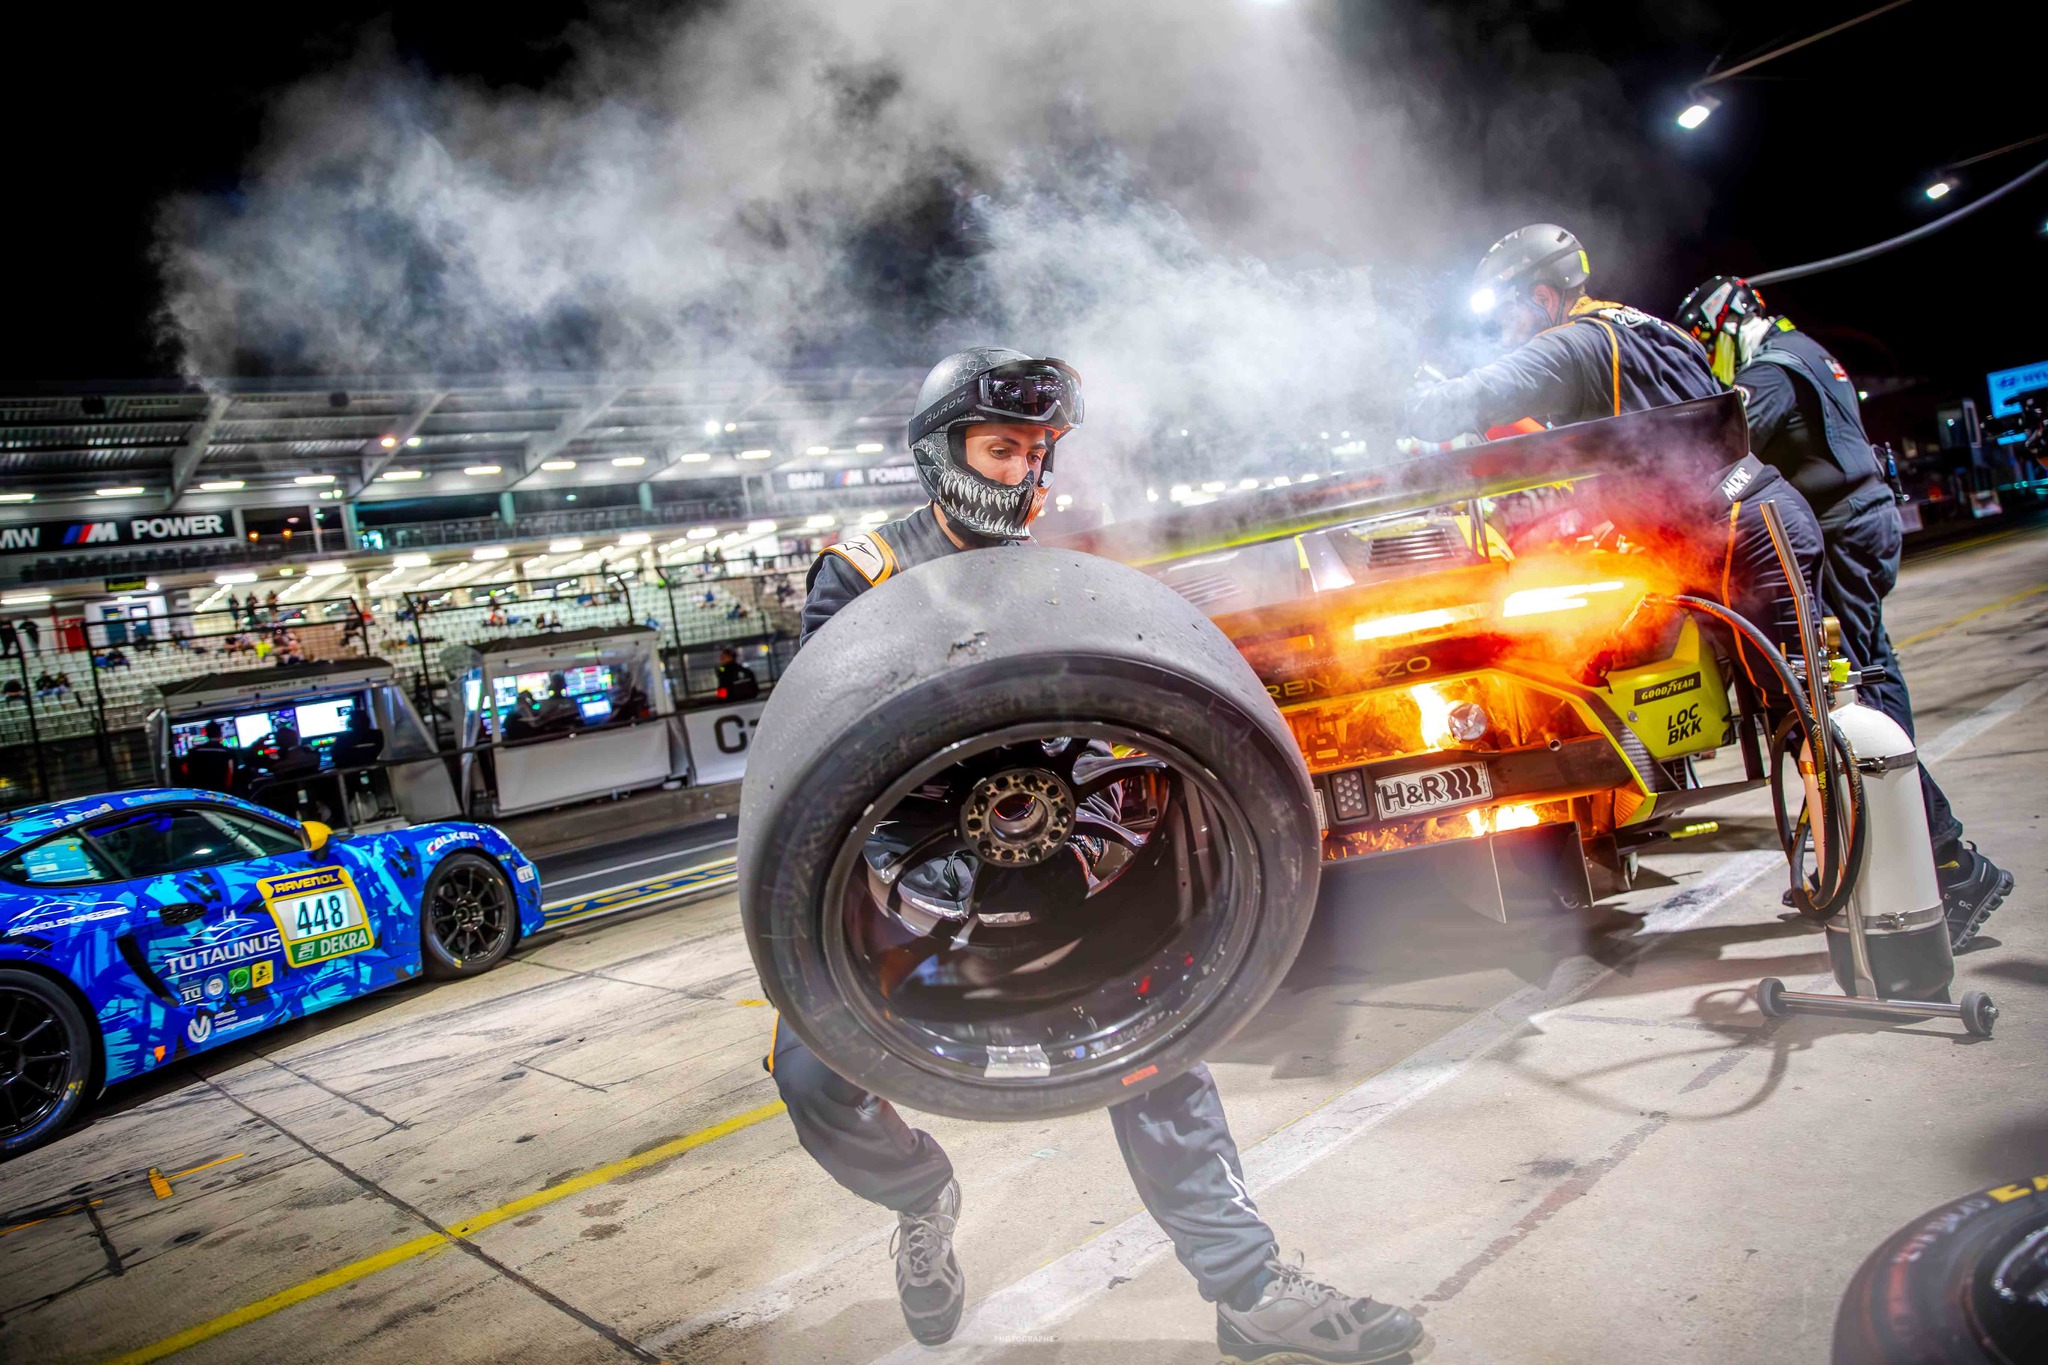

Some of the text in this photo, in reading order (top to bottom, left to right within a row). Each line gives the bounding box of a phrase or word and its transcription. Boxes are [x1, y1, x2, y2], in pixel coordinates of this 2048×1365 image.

[925, 391, 967, 424] RUROC
[867, 466, 917, 485] POWE
[0, 515, 223, 548] MW M POWER
[1641, 678, 1695, 700] GOODYEAR
[1667, 703, 1699, 730] LOC
[1667, 717, 1702, 746] BKK
[1381, 776, 1443, 810] H&R
[426, 831, 480, 856] FALKEN
[274, 874, 338, 893] RAVENOL
[297, 895, 343, 935] 448
[198, 933, 281, 965] TAUNUS
[320, 929, 368, 956] DEKRA
